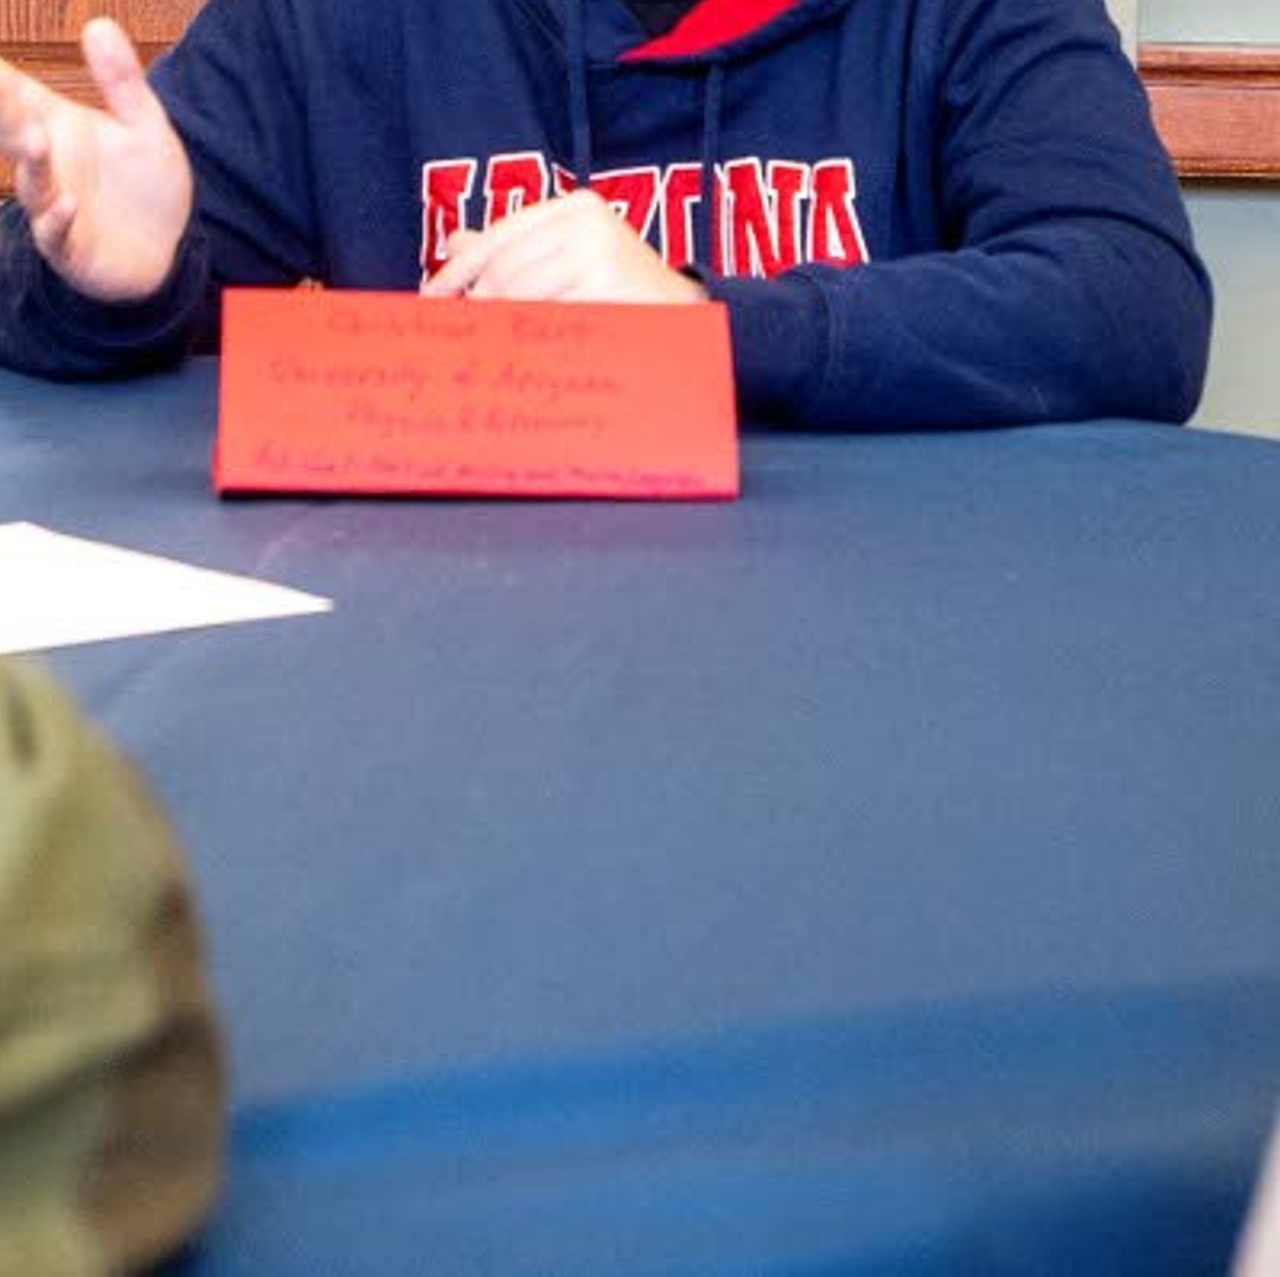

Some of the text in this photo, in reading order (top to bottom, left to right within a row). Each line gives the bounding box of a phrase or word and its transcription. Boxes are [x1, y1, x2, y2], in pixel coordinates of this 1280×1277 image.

[420, 151, 872, 288] ARZONA
[266, 361, 623, 403] University of Arizona
